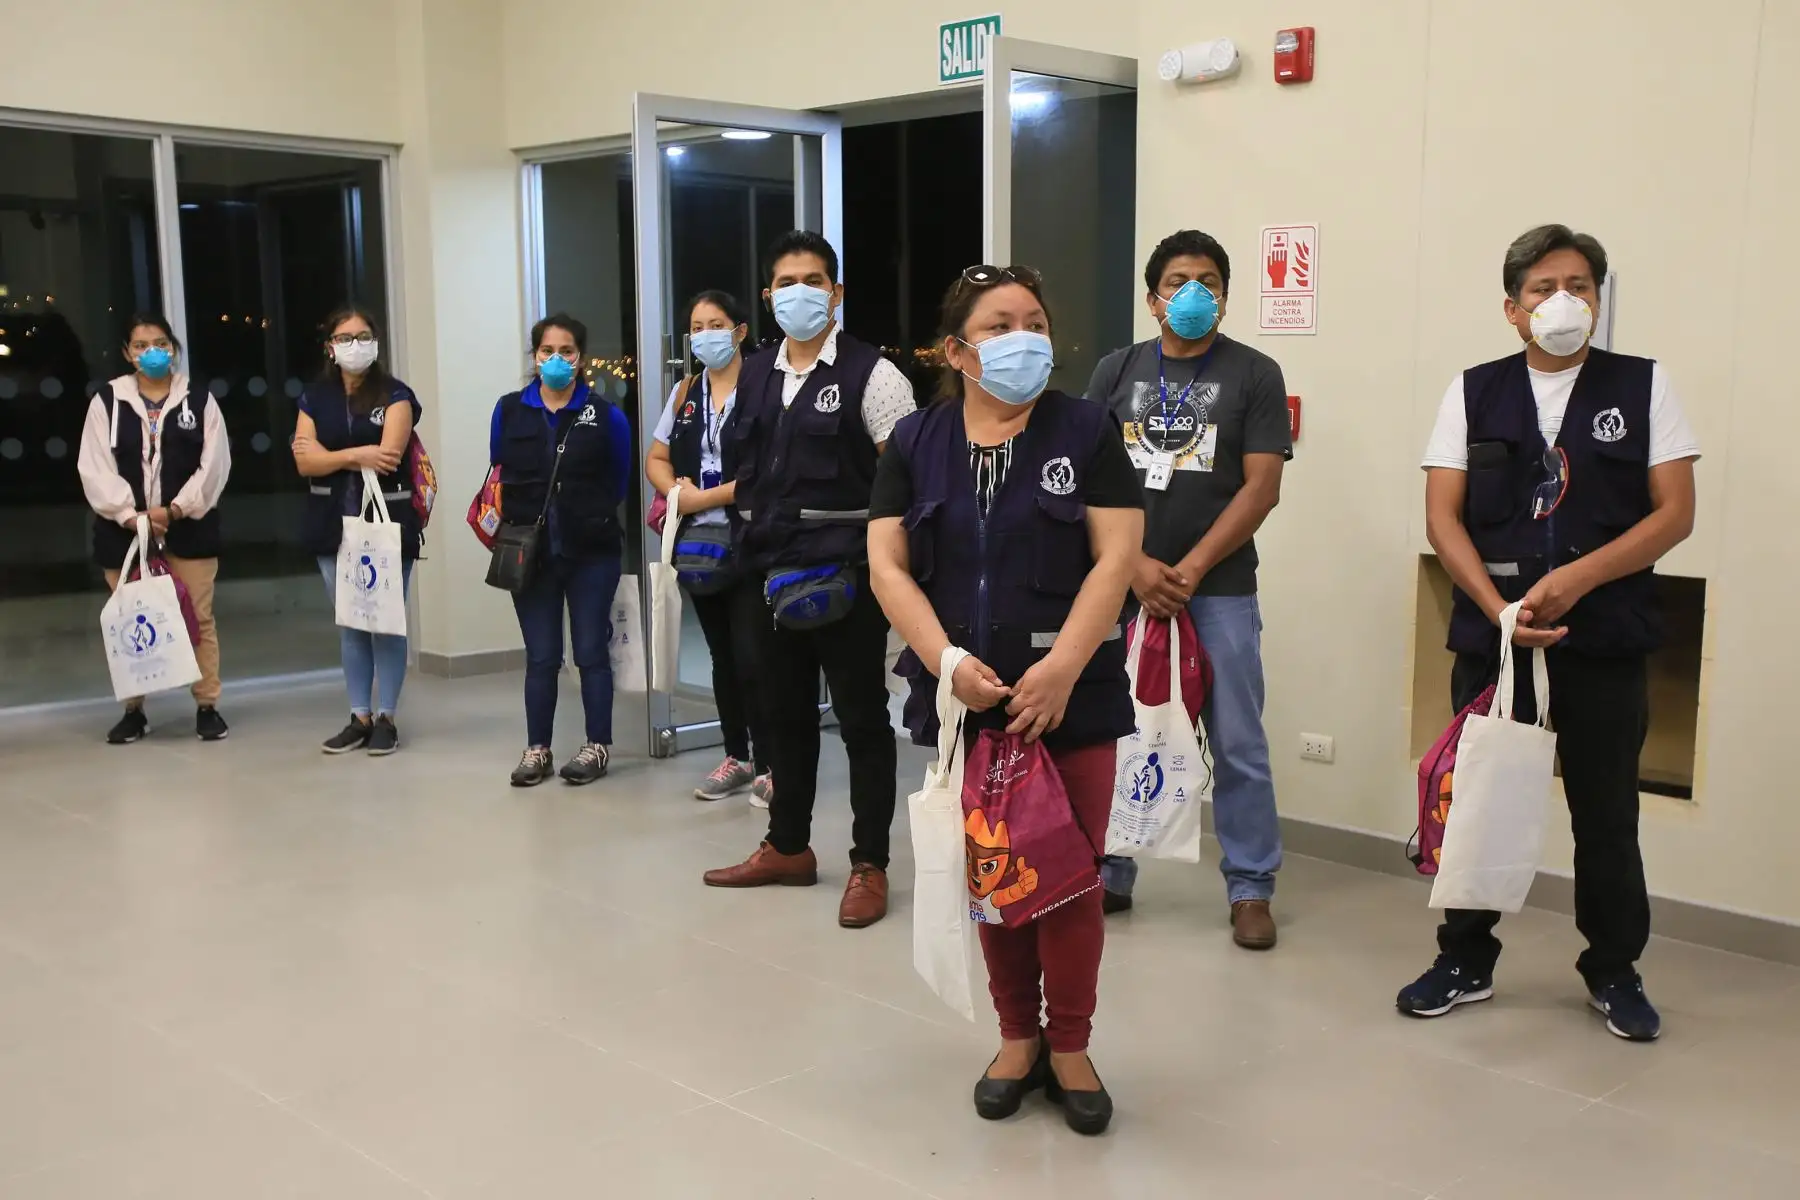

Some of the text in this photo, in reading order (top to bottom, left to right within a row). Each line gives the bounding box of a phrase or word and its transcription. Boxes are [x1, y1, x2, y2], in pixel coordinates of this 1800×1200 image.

[942, 21, 996, 76] SALID
[1272, 299, 1302, 307] ALARMA
[1272, 308, 1302, 316] CONTRA
[1268, 317, 1305, 325] INCENDIOS
[969, 900, 984, 912] ima
[969, 910, 987, 922] 019
